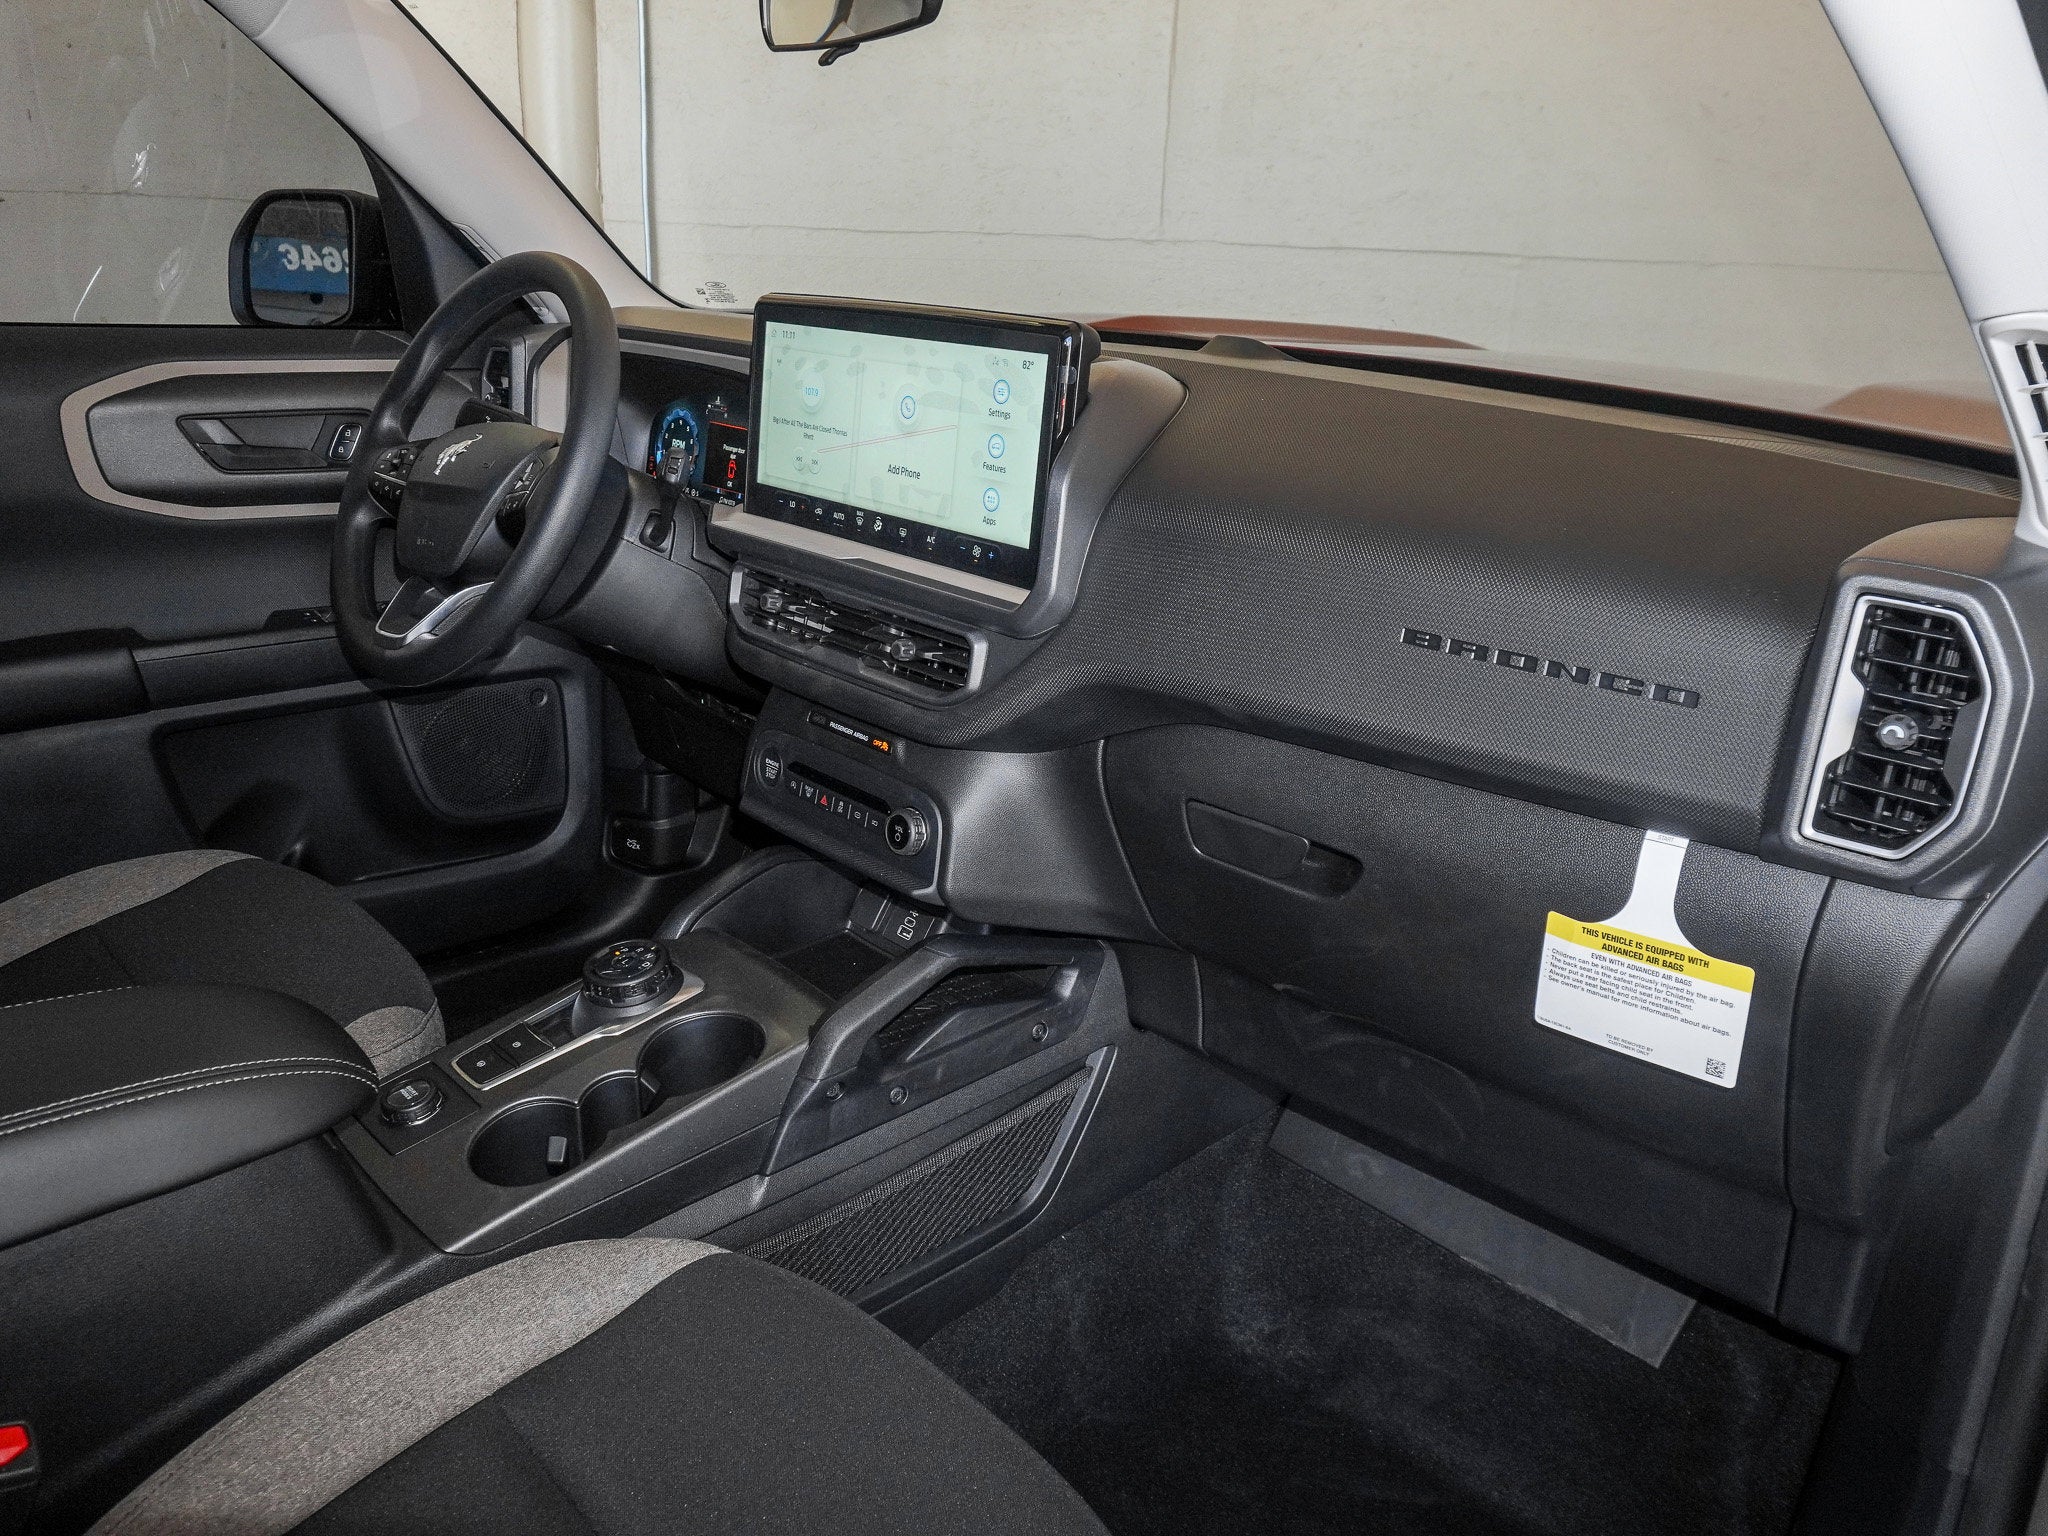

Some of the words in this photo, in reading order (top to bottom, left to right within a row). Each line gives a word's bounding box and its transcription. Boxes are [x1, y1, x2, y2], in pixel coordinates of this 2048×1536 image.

[988, 408, 1011, 420] Settings
[672, 438, 686, 450] RPM
[888, 464, 900, 475] Add
[900, 466, 921, 480] Phone
[982, 461, 1006, 473] Features
[833, 512, 844, 520] AUTO
[982, 516, 996, 526] Apps
[1400, 627, 1700, 709] BRONCO
[829, 722, 854, 736] PASSENGER
[853, 731, 869, 742] AIRBAG
[1582, 927, 1600, 938] THIS
[1601, 932, 1634, 947] VEHICLE
[1636, 942, 1643, 950] IS
[1645, 944, 1685, 961] EQUIPPED
[1688, 956, 1710, 968] WITH
[1602, 943, 1644, 961] ADVANCED
[1646, 955, 1660, 965] AIR
[1662, 960, 1685, 972] BAGS
[1551, 948, 1577, 961] Children
[1601, 964, 1619, 974] killed
[1628, 973, 1659, 986] seriously
[1660, 982, 1685, 993] injured
[1686, 989, 1695, 997] by
[1696, 992, 1708, 1000] the
[1720, 999, 1736, 1009] bag.
[1551, 955, 1562, 963] The
[1563, 960, 1578, 969] back
[1579, 965, 1593, 973] seat
[1601, 971, 1612, 979] the
[1613, 975, 1633, 985] safest
[1634, 981, 1653, 991] place
[1665, 990, 1697, 1004] Children.
[1591, 953, 1608, 962] EVEN
[1608, 958, 1625, 967] WITH
[1627, 963, 1660, 977] ADVANCED
[1662, 973, 1673, 981] AIR
[1675, 977, 1693, 987] BAGS
[1549, 969, 1571, 981] Always
[1585, 981, 1599, 989] seat
[1599, 985, 1616, 994] belts
[1617, 990, 1630, 998] and
[1630, 995, 1648, 1004] child
[1649, 1000, 1682, 1014] restraints.
[1550, 962, 1567, 972] Never
[1585, 974, 1598, 982] rear
[1599, 978, 1620, 989] facing
[1621, 985, 1638, 993] child
[1639, 990, 1653, 998] seat
[1662, 997, 1674, 1005] the
[1675, 1001, 1694, 1011] front.
[1548, 975, 1560, 983] See
[1560, 980, 1585, 992] owner's
[1586, 988, 1610, 999] manual
[1611, 995, 1621, 1003] for
[1622, 1000, 1639, 1008] more
[1640, 1005, 1679, 1021] information
[1680, 1017, 1701, 1028] about
[1712, 1027, 1732, 1038] bags.
